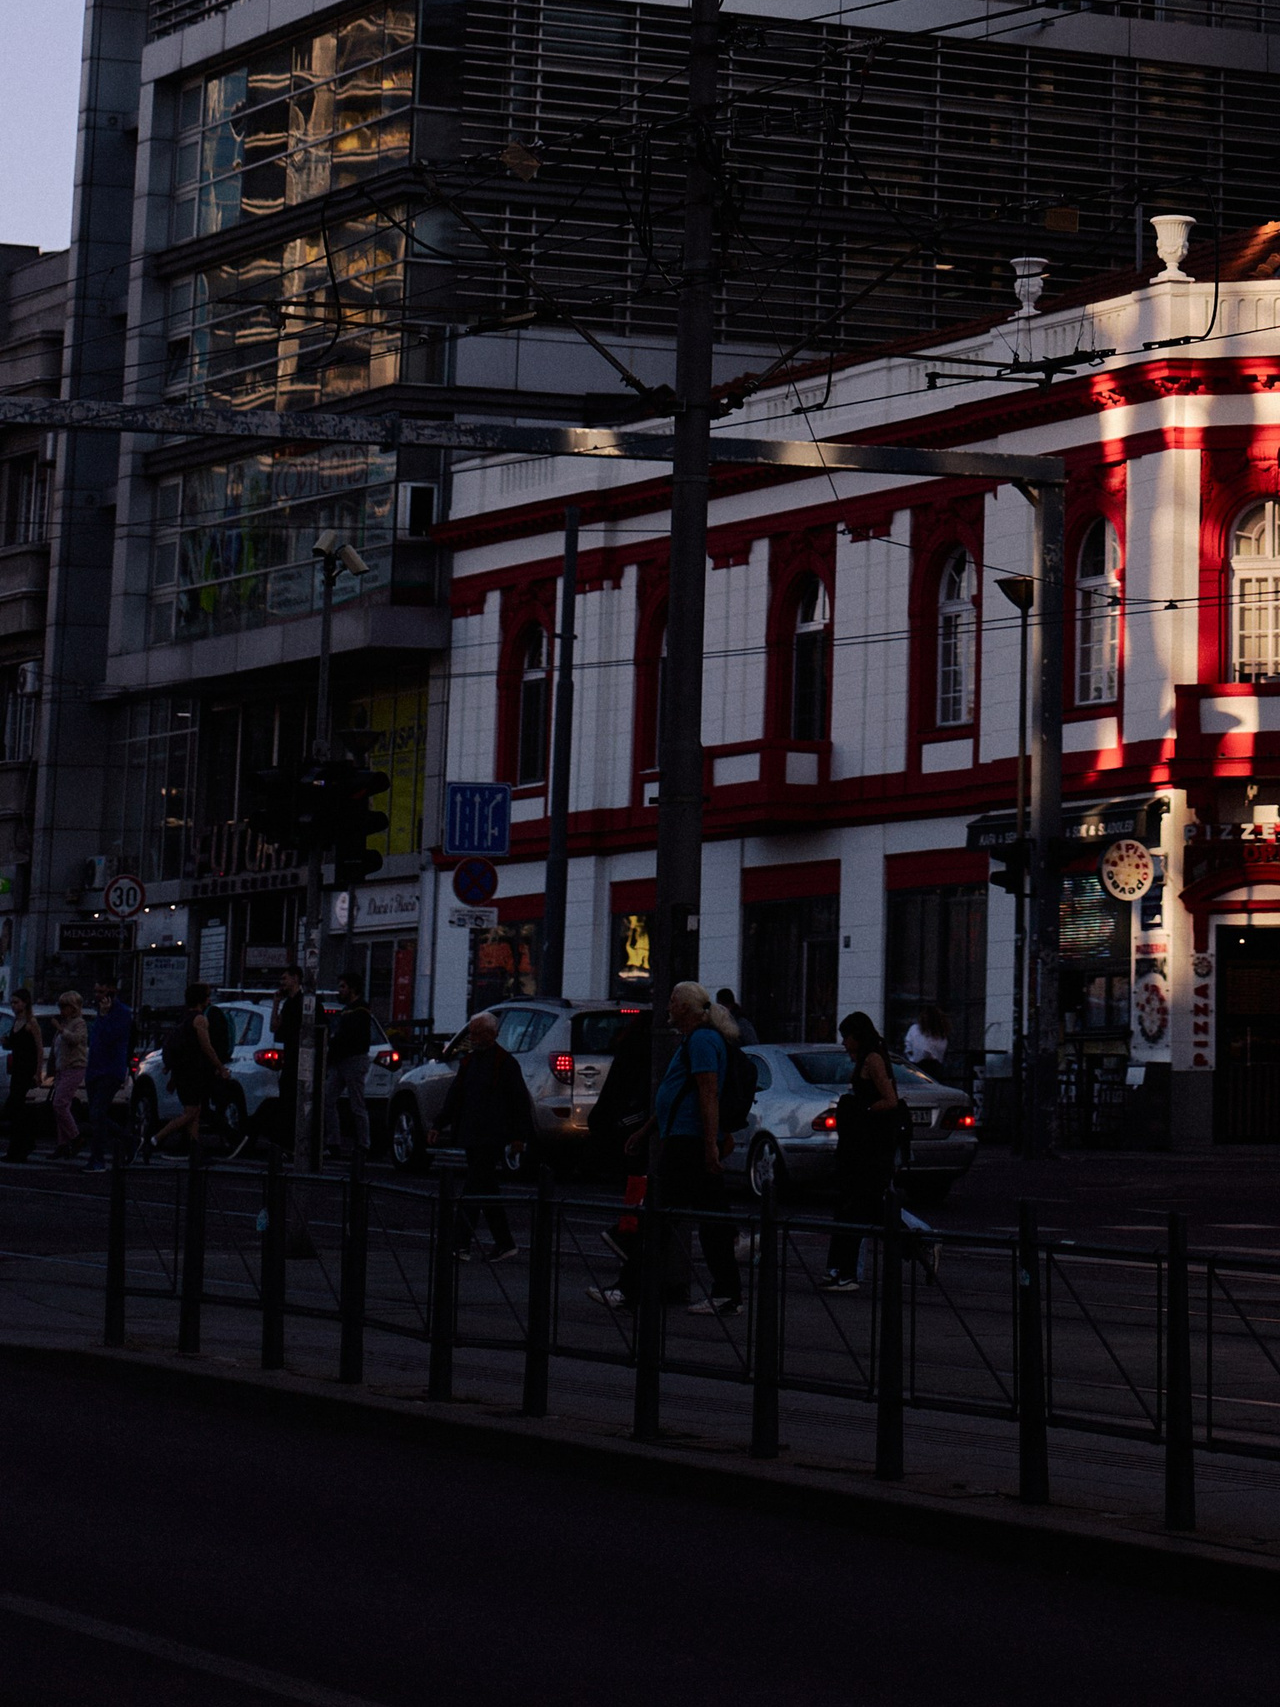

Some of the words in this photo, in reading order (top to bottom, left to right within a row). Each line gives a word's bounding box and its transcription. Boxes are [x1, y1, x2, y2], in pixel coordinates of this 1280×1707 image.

[241, 872, 300, 891] CENTAR
[112, 886, 138, 908] 30
[1193, 984, 1209, 1066] PIZZA
